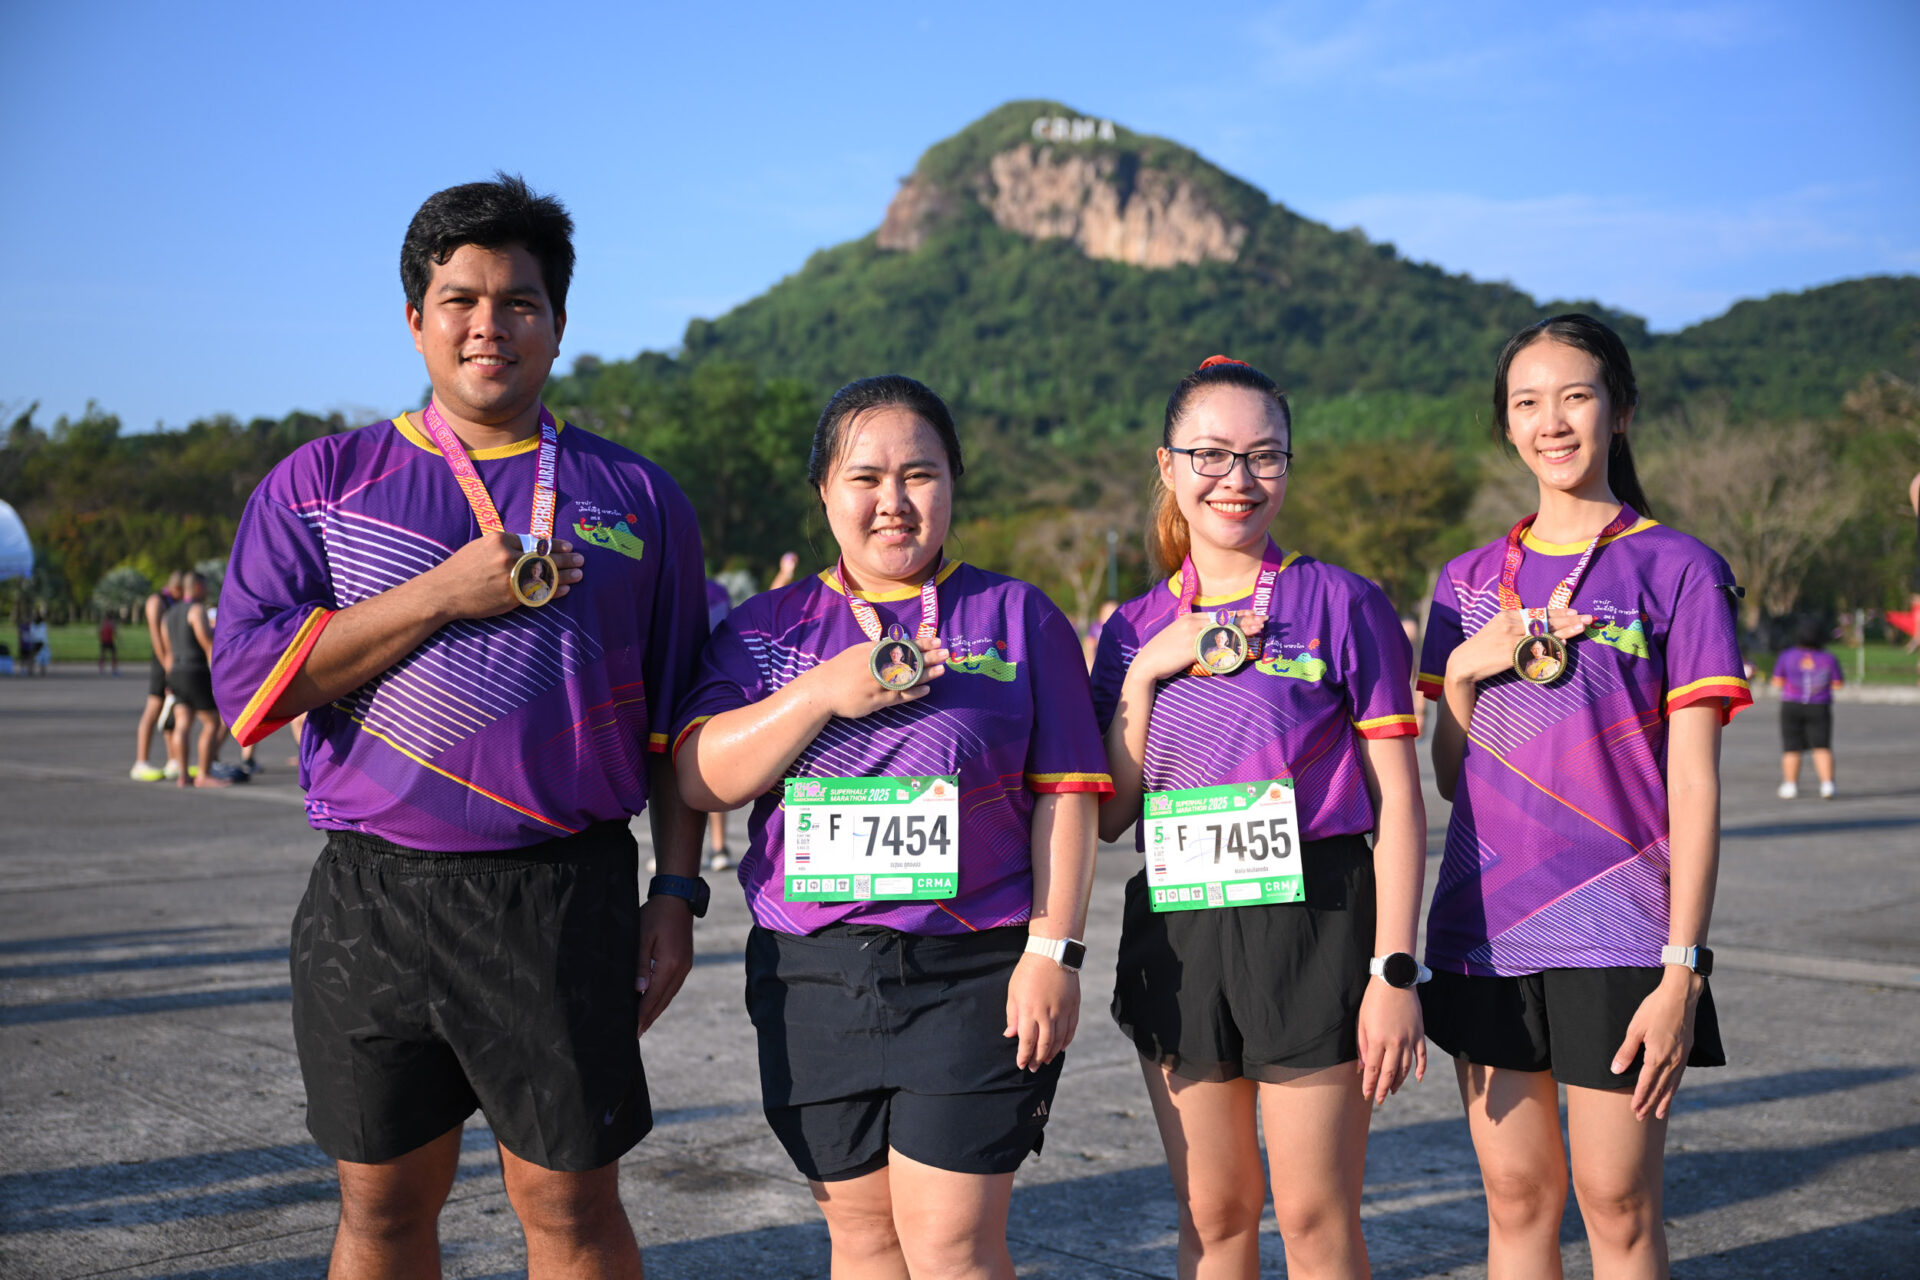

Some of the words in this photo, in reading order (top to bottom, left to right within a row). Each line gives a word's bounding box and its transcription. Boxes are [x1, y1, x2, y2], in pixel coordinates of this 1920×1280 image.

[425, 404, 441, 430] THE
[435, 426, 475, 480] GREATEST
[467, 480, 489, 508] RUN
[481, 510, 497, 527] OF
[538, 442, 557, 489] MARATHON
[1503, 545, 1520, 593] EATEST
[922, 578, 936, 624] MARATHO
[1253, 587, 1272, 616] ATHON
[868, 788, 891, 802] 2025
[1208, 796, 1229, 811] 2025
[797, 813, 812, 832] 5
[829, 814, 842, 841] F
[862, 815, 951, 857] 7454
[1154, 826, 1164, 844] 5
[1177, 825, 1187, 851] F
[1206, 817, 1292, 864] 7455
[917, 878, 952, 888] CRMA
